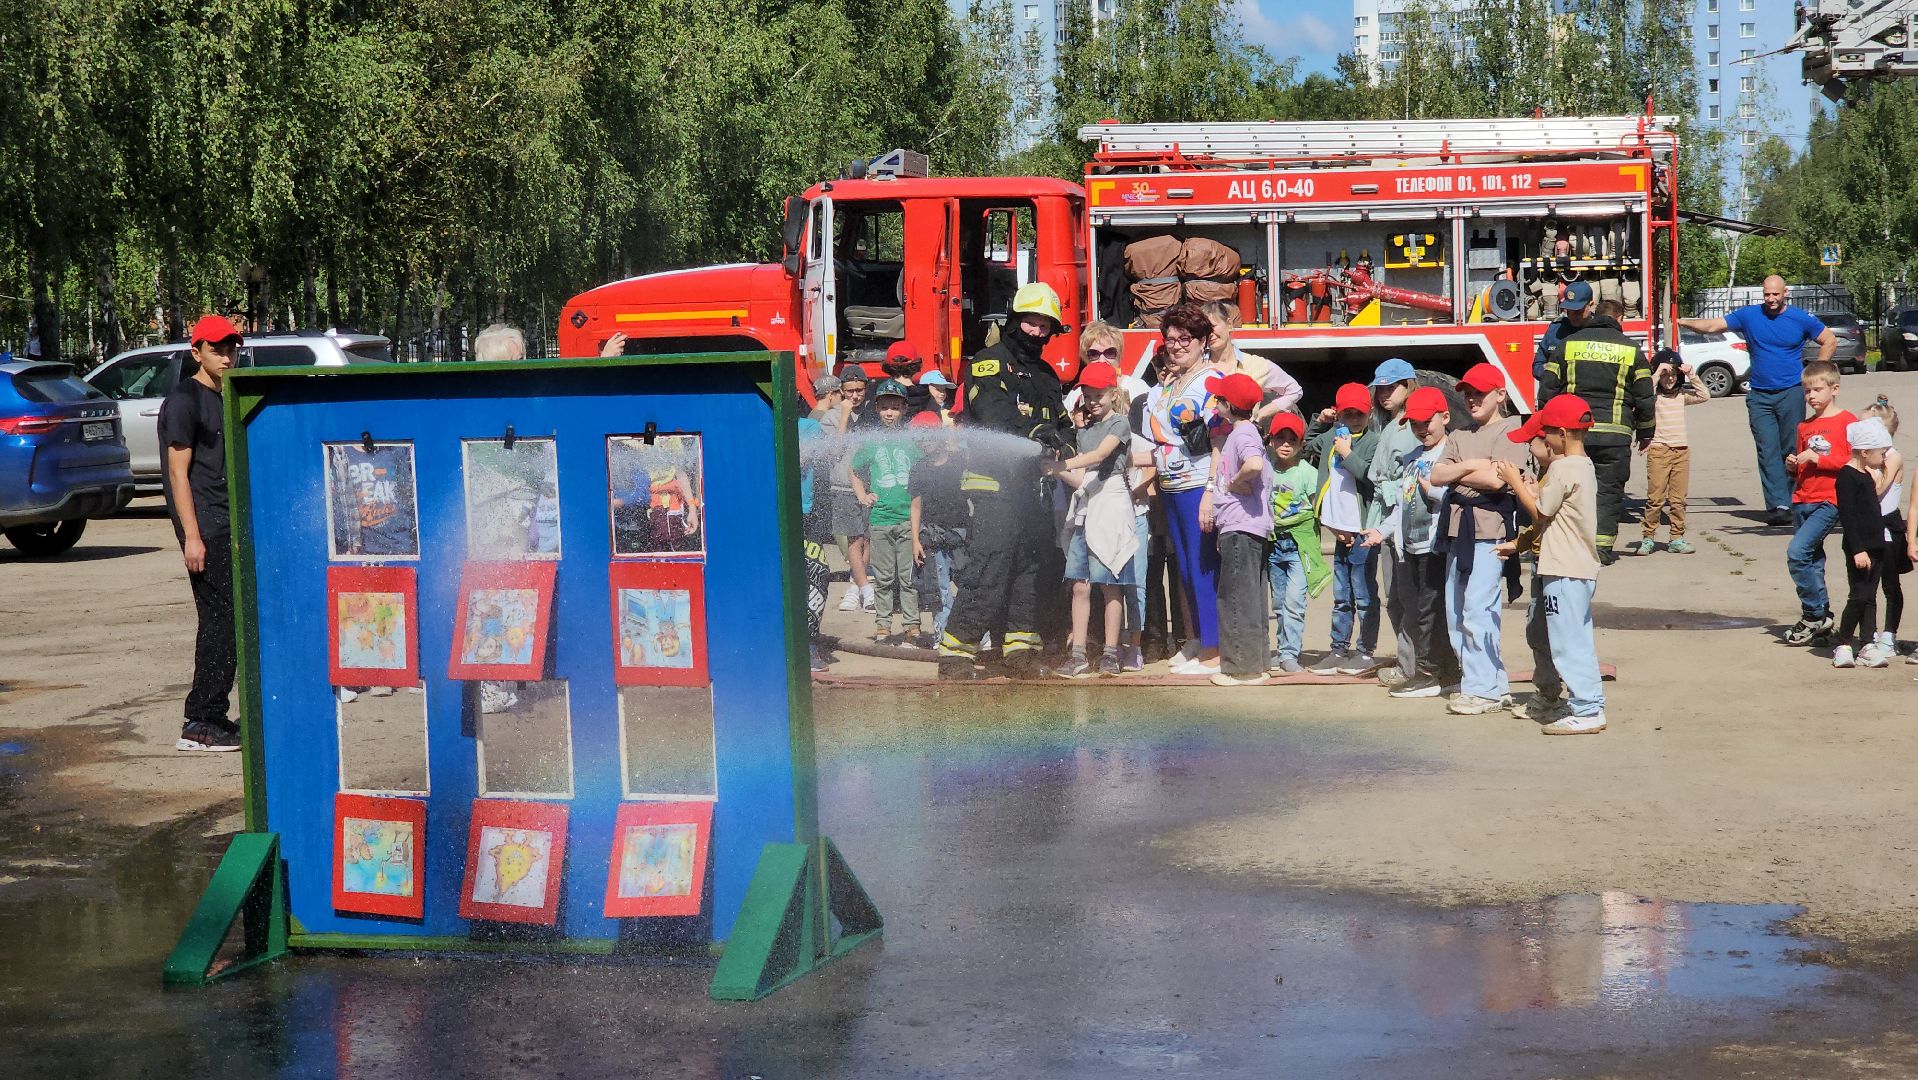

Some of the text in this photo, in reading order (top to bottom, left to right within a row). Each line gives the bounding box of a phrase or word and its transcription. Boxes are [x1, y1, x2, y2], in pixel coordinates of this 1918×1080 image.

[1131, 181, 1149, 194] 30
[1395, 173, 1532, 193] ТЕЛЕФОН 01, 101, 112
[1227, 178, 1315, 202] АЦ 6,0-40
[1586, 342, 1614, 352] МЧС
[1573, 352, 1626, 364] РОССИИ
[977, 363, 996, 373] 62
